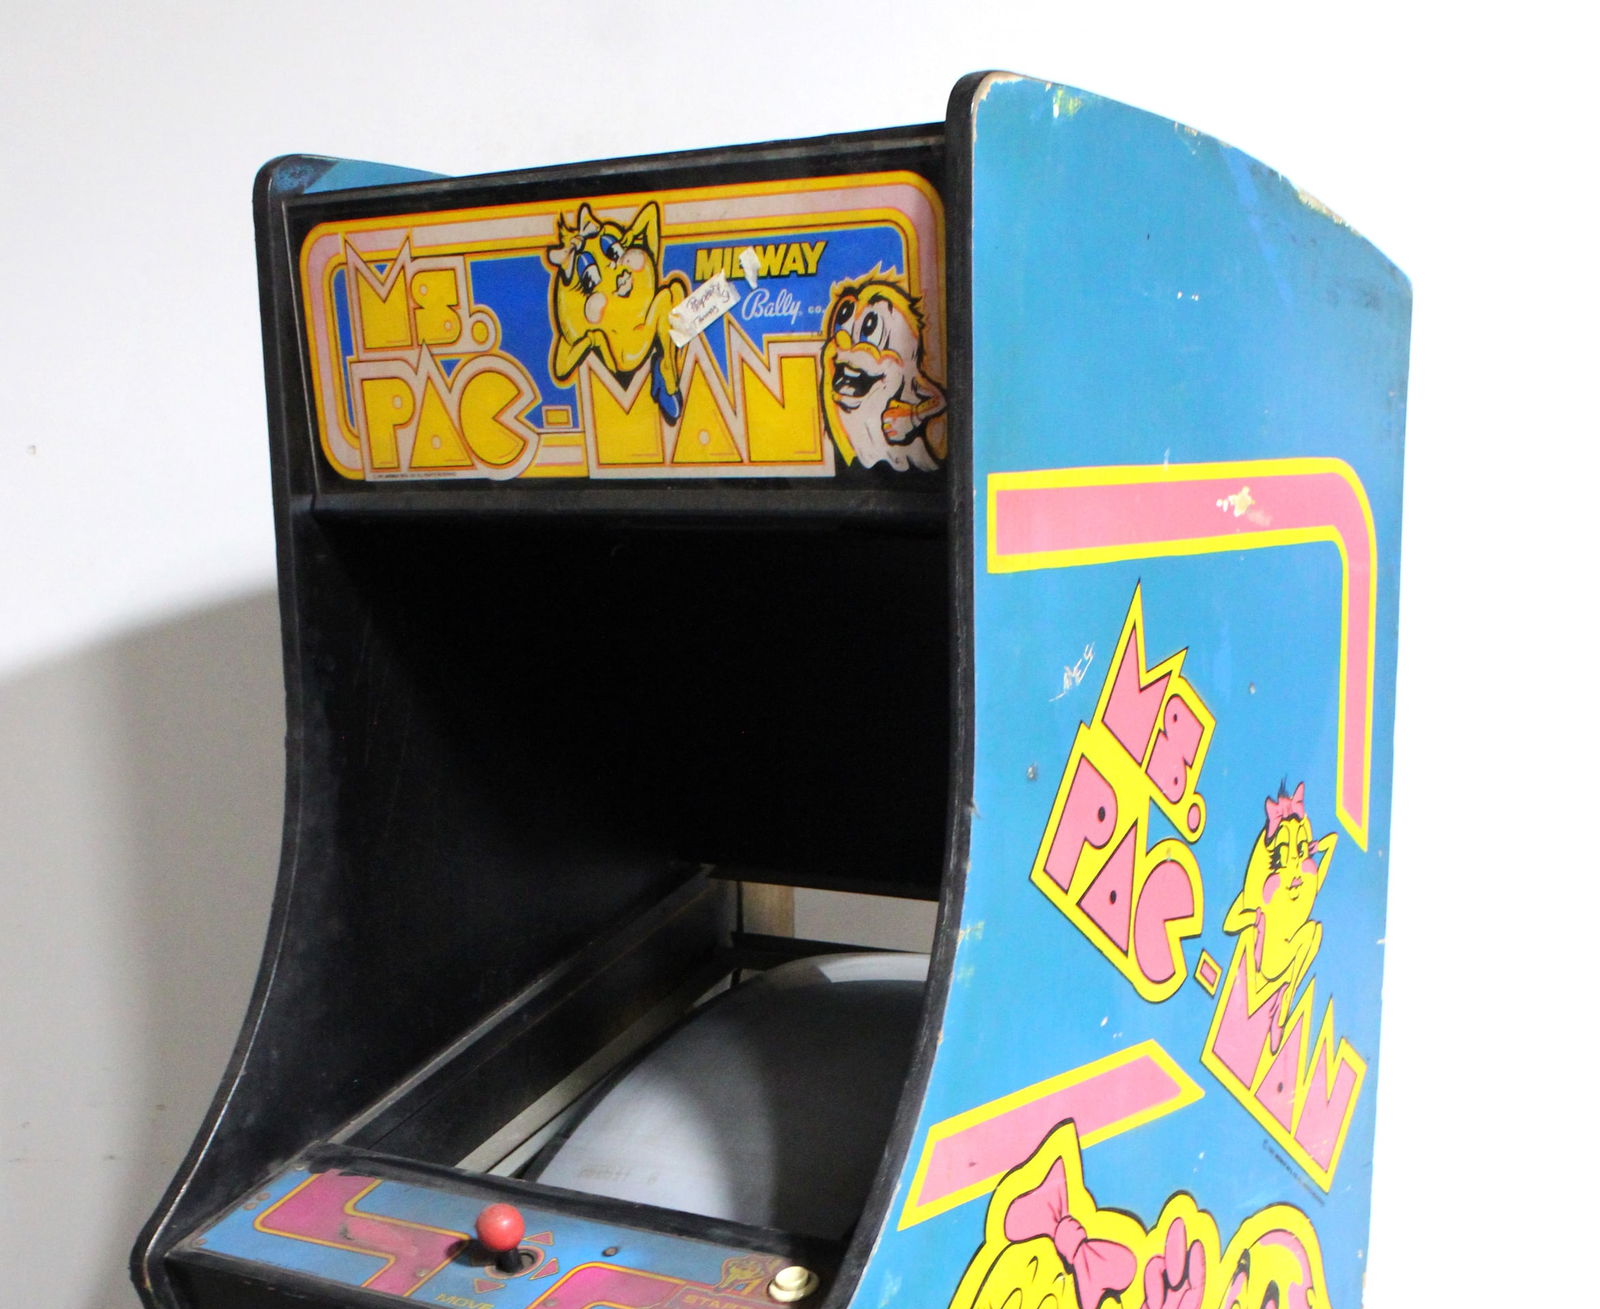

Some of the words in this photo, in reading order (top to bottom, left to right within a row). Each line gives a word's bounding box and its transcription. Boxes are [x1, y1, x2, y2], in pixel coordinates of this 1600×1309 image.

[347, 240, 495, 353] MS.
[741, 288, 801, 325] Bally
[354, 328, 832, 479] PAC-MAN
[1096, 588, 1214, 842] MS.
[1035, 725, 1366, 1190] PAC-MAN
